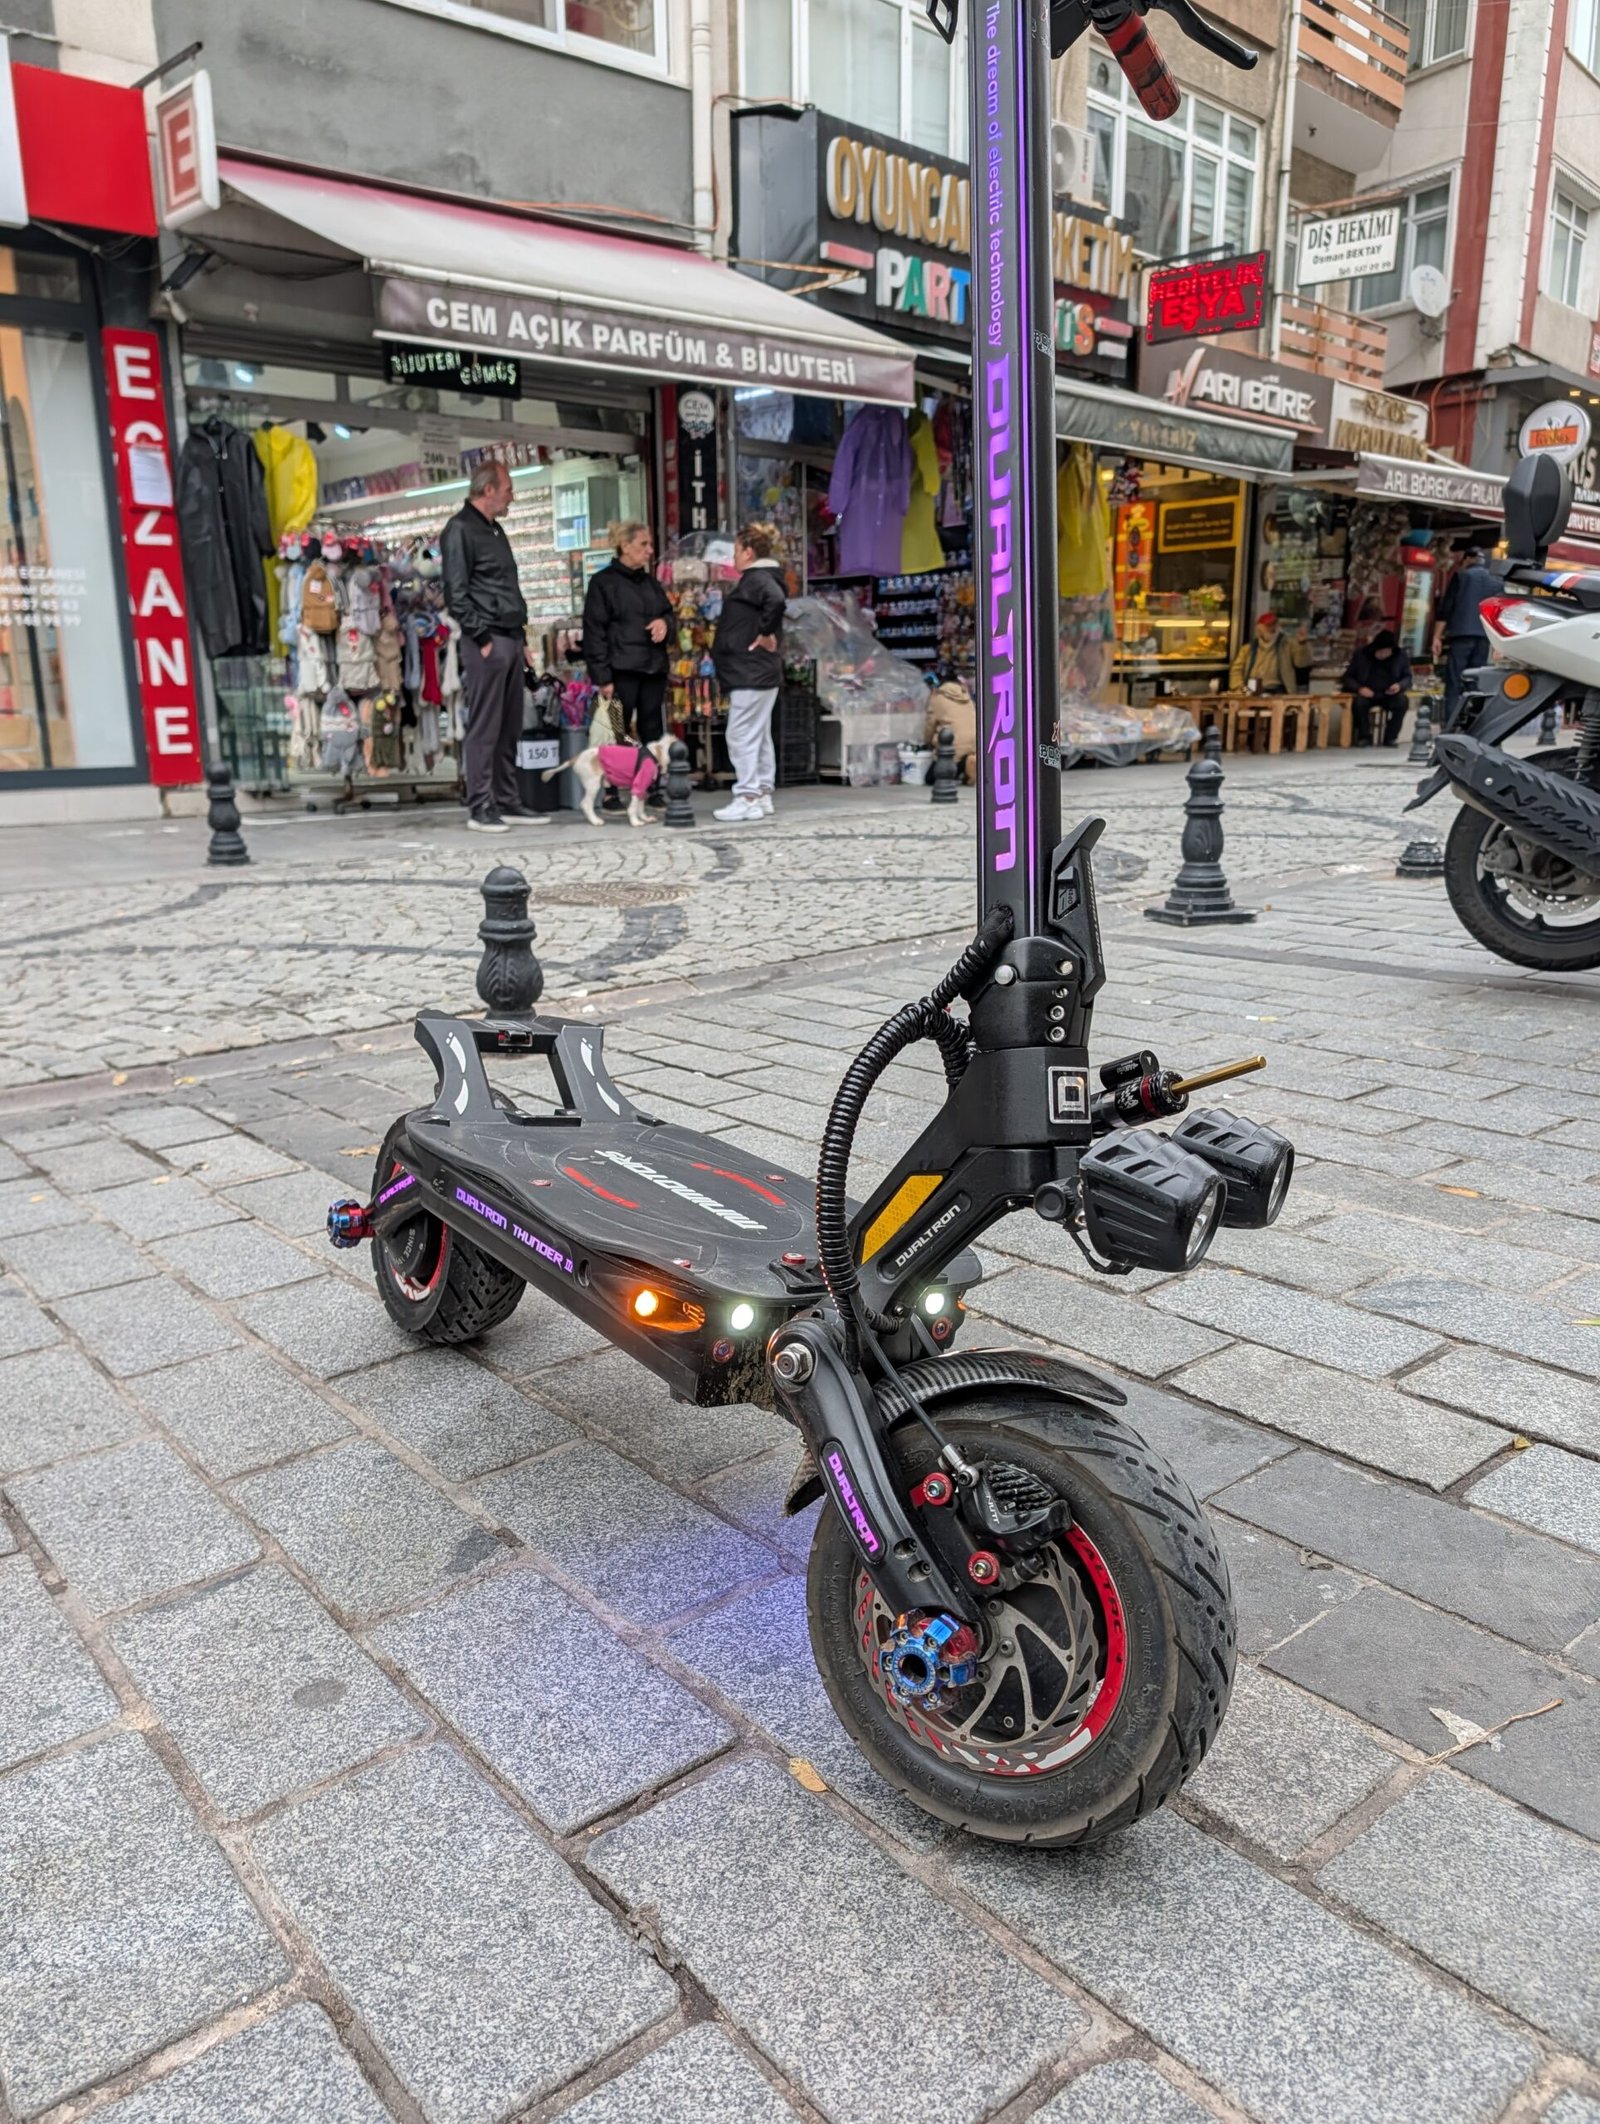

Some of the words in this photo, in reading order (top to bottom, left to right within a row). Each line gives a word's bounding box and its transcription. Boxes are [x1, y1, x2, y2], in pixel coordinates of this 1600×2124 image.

[986, 1, 999, 39] The
[985, 44, 999, 117] dream
[167, 108, 198, 197] E
[987, 123, 1003, 142] of
[988, 148, 1003, 225] electric
[1308, 223, 1332, 252] DİŞ
[1337, 208, 1393, 245] HEKİMİ
[875, 247, 970, 325] PART
[1054, 297, 1095, 356] ÜS
[988, 229, 1005, 348] technology
[1161, 286, 1246, 332] EŞYA
[427, 297, 497, 335] CEM
[507, 311, 584, 350] AÇIK
[592, 323, 707, 365] PARFÜM
[715, 343, 735, 369] &
[741, 343, 856, 386] BİJUTERİ
[1198, 369, 1241, 406] ARI
[987, 353, 1016, 872] DUALTRON
[528, 748, 549, 760] 150
[380, 1174, 416, 1204] DUALTRON
[594, 1149, 768, 1231] MINIMOTORS
[403, 1228, 416, 1259] SINCE
[456, 1187, 508, 1230] DUALTRON
[512, 1223, 564, 1271] THUNDER
[895, 1204, 961, 1268] DUALTRON
[828, 1452, 879, 1553] DUALTRON
